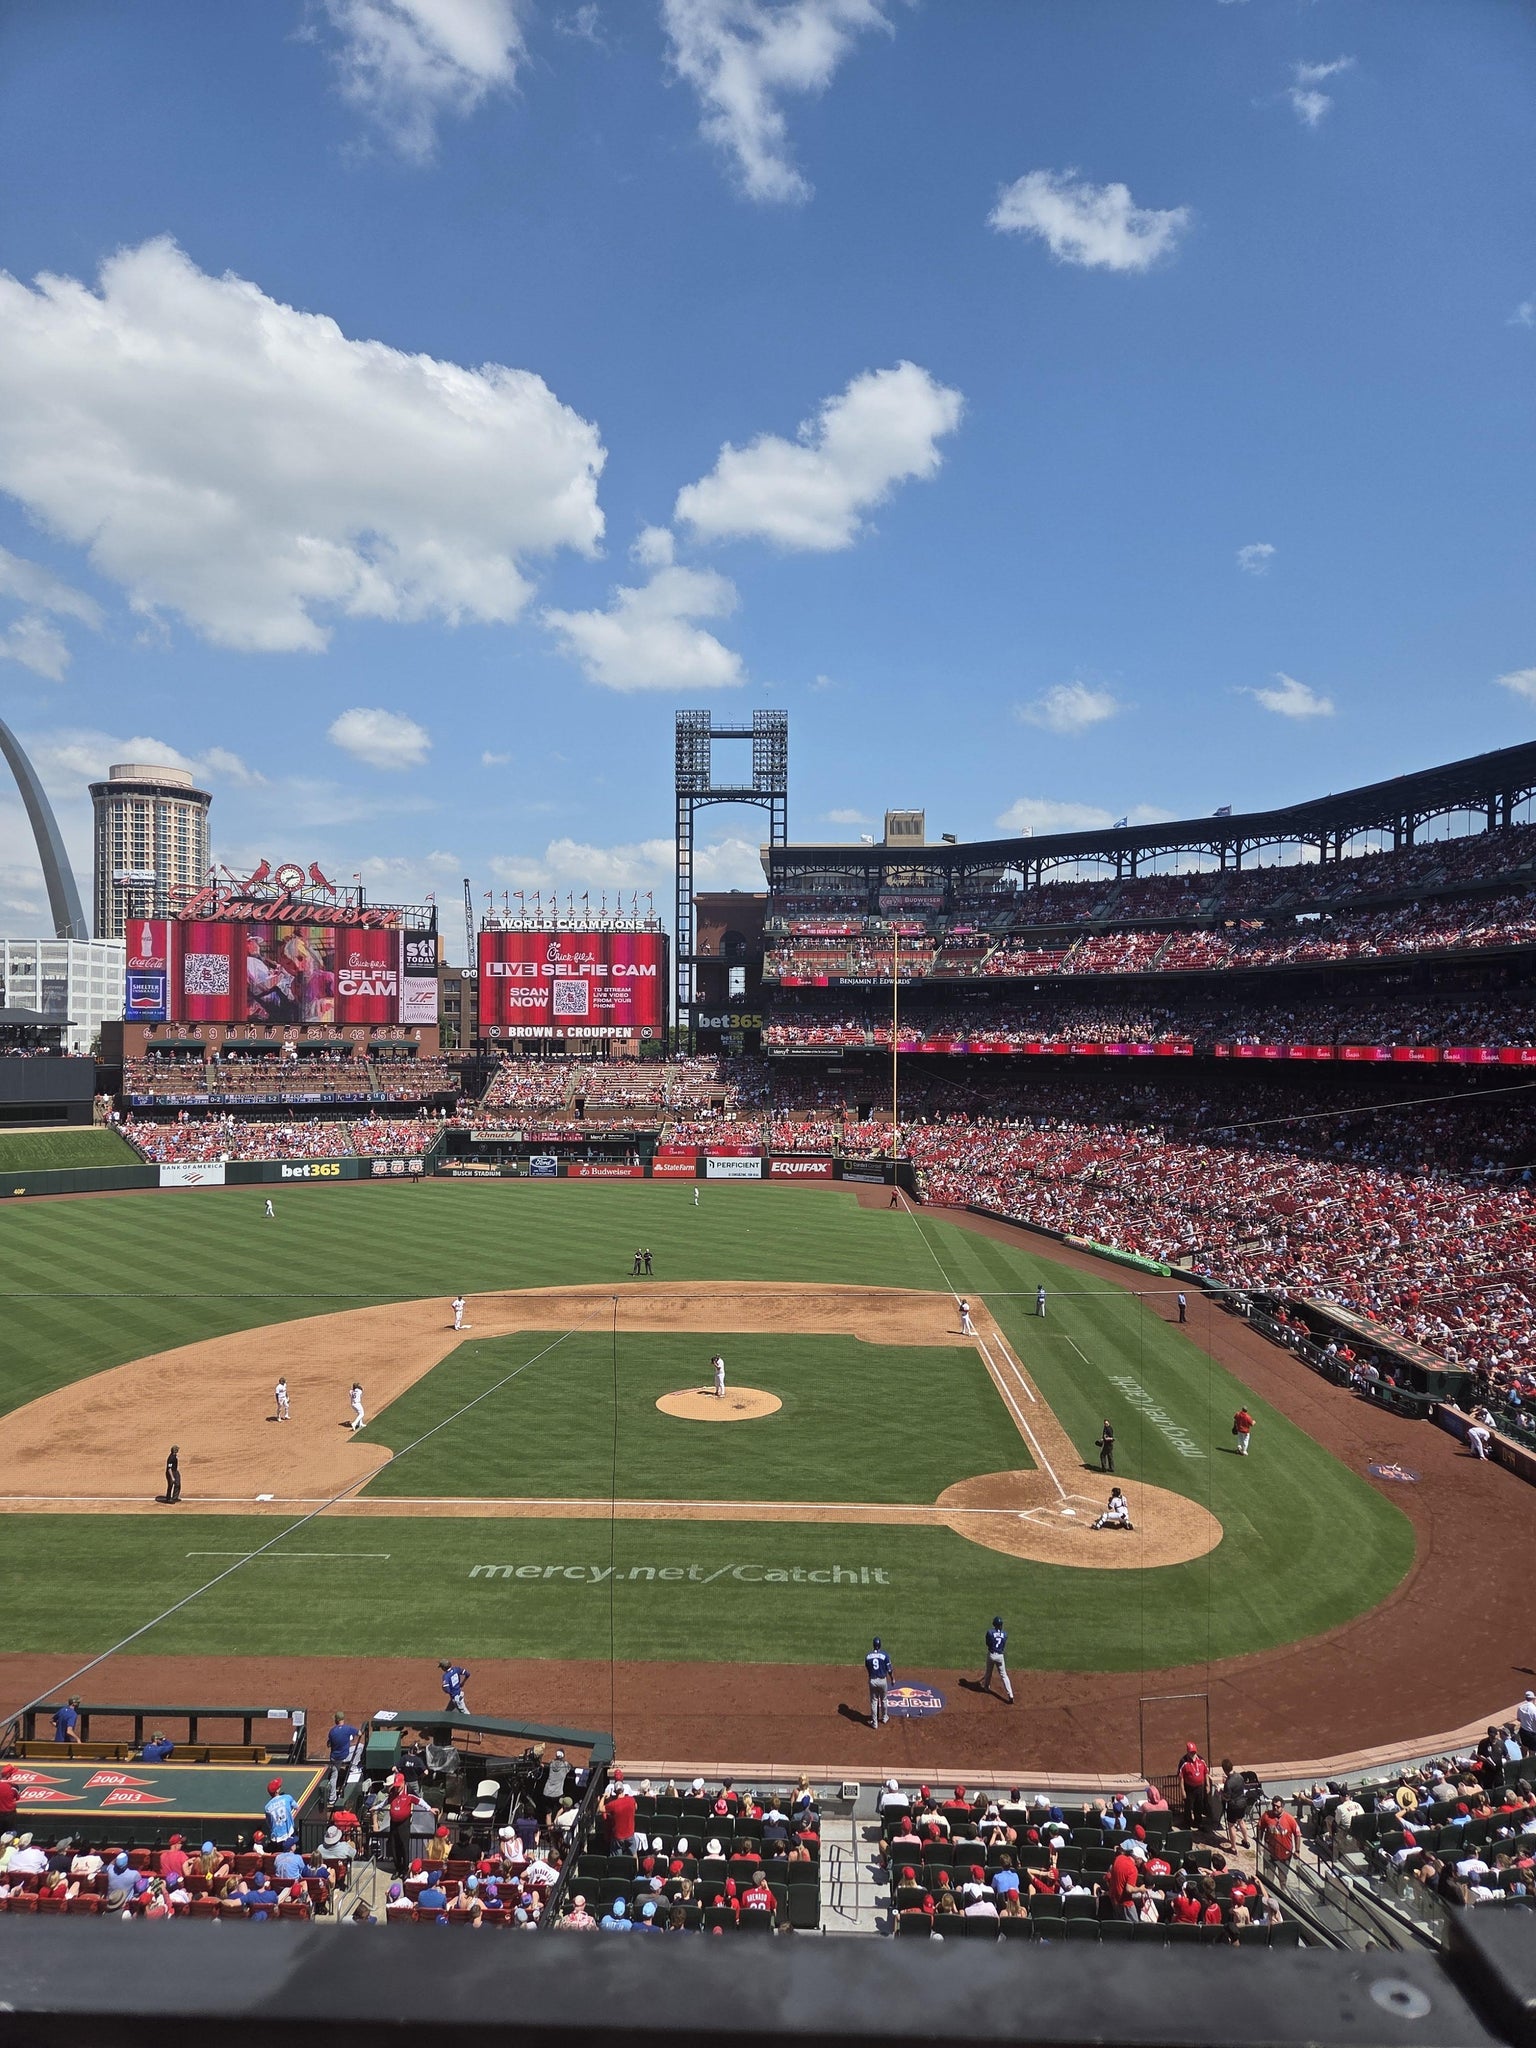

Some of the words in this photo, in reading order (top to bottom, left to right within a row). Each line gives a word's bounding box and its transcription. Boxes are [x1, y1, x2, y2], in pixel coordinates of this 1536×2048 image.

[168, 884, 403, 924] Budweiser
[499, 918, 552, 929] WORLD
[556, 918, 645, 929] CHAMPIONS
[407, 940, 435, 956] stl
[547, 943, 595, 963] Chick-fil-A
[338, 970, 397, 980] SELFIE
[489, 963, 534, 976] LIVE
[541, 964, 608, 976] SELFIE
[611, 964, 656, 976] CAM
[338, 980, 397, 996] CAM
[510, 987, 549, 996] SCAN
[510, 997, 548, 1007] NOW
[698, 1013, 763, 1028] bet365
[165, 1028, 171, 1039] 1
[177, 1028, 187, 1039] 2
[193, 1028, 202, 1039] 6
[208, 1028, 218, 1039] 9
[225, 1028, 238, 1039] 10
[283, 1028, 299, 1040] 20
[349, 1029, 365, 1040] 42
[371, 1029, 387, 1040] 45
[508, 1027, 552, 1037] BROWN
[556, 1028, 564, 1037] &
[567, 1027, 632, 1037] CROUPPEN
[474, 1131, 516, 1139] Schnucks
[535, 1157, 552, 1166] Ford
[281, 1163, 340, 1178] bet365
[591, 1167, 632, 1175] Budweiser
[771, 1162, 828, 1174] EQUIFAX
[468, 1563, 890, 1584] mercy.net/CatchIt
[996, 1637, 1002, 1648] 7
[872, 1658, 880, 1670] 9
[909, 1698, 942, 1708] Bull
[11, 1773, 37, 1782] 985
[91, 1775, 126, 1784] 2004
[20, 1790, 55, 1799] 1987
[110, 1792, 142, 1801] 2013
